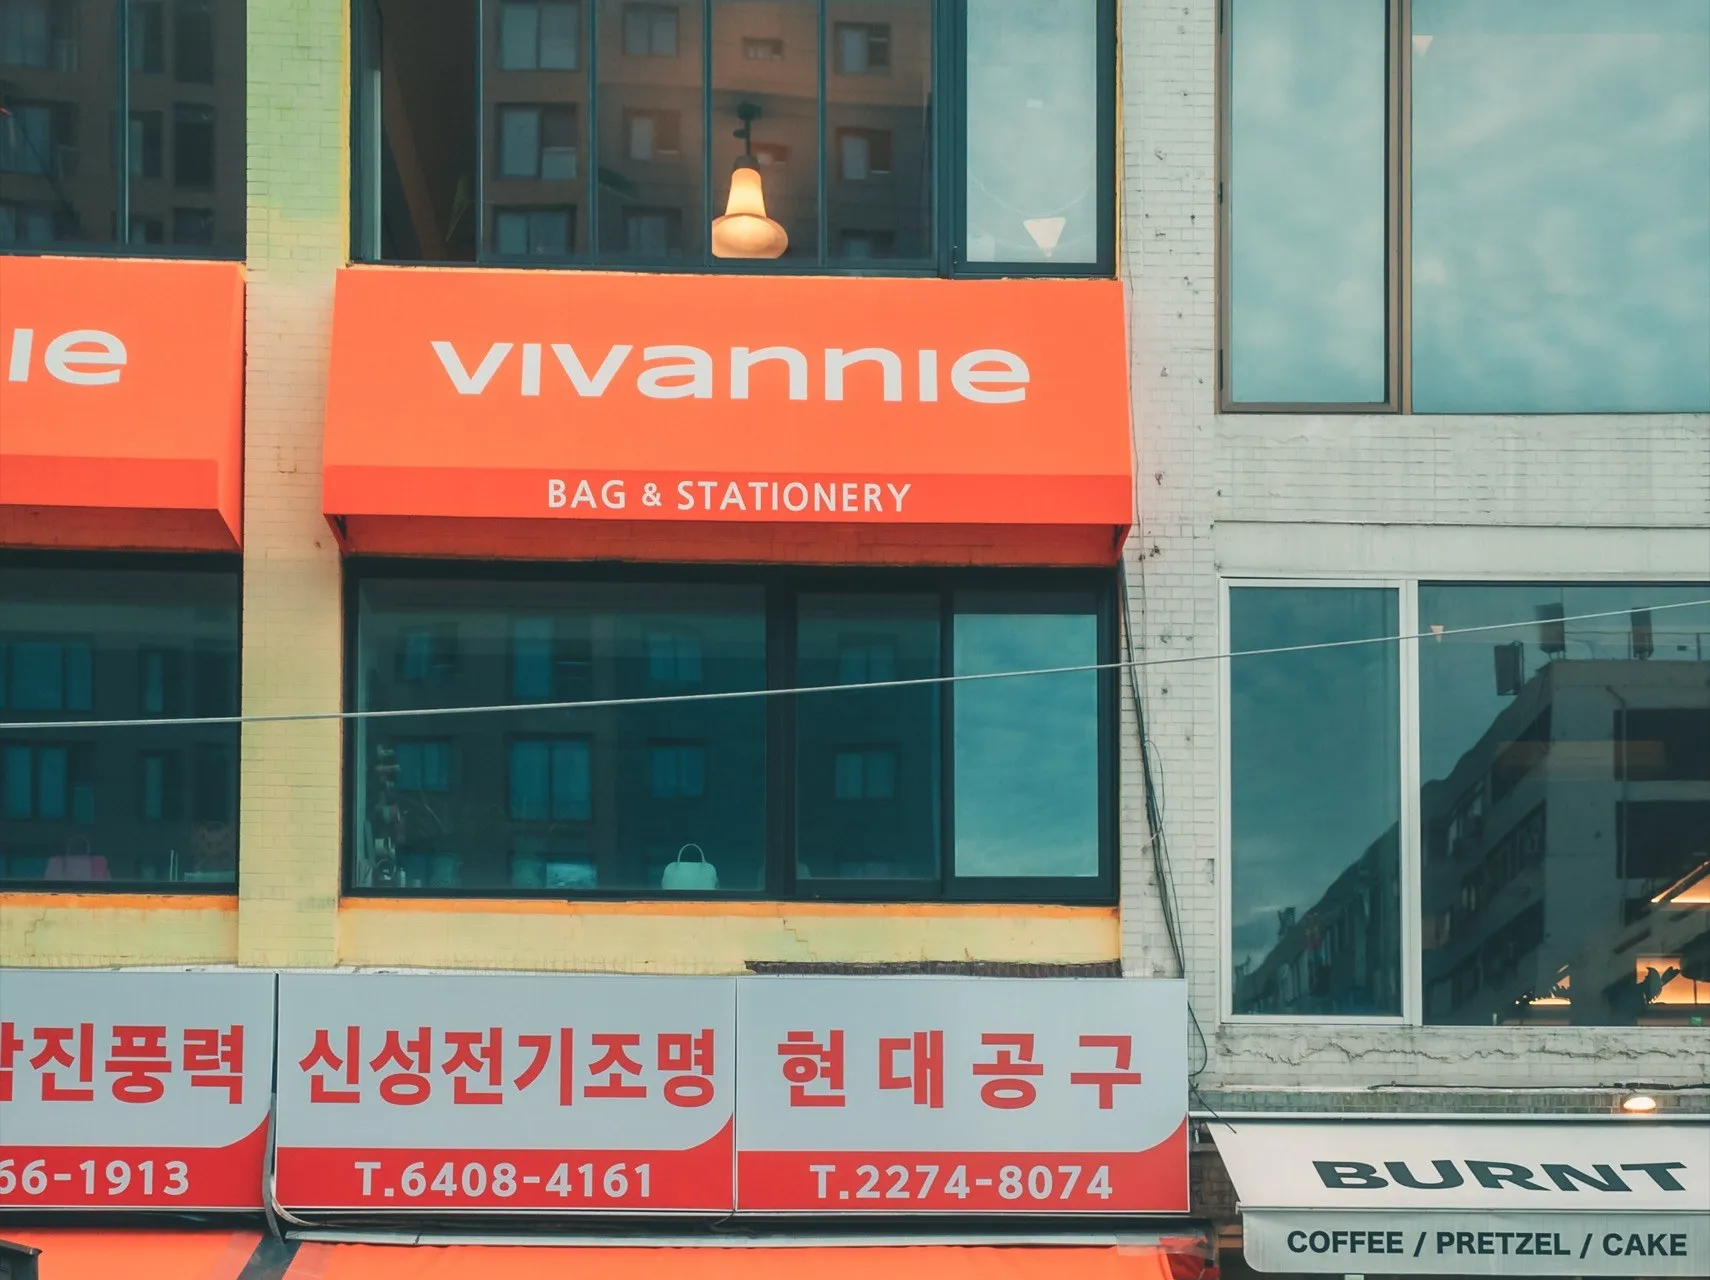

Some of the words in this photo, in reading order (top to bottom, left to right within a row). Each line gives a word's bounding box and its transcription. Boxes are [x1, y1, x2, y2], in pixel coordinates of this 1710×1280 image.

[431, 341, 1030, 404] vivannie
[548, 480, 626, 510] BAG
[641, 483, 662, 508] &
[677, 481, 911, 513] STATIONERY
[300, 1026, 714, 1107] 신성전기조명
[354, 1161, 651, 1198] T.6408-4161
[809, 1164, 1113, 1200] T.2274-8074
[1312, 1159, 1687, 1192] BURNT
[1286, 1230, 1404, 1255] COFFEE
[1436, 1231, 1572, 1256] PRETZEL
[1602, 1233, 1688, 1257] CAKE
